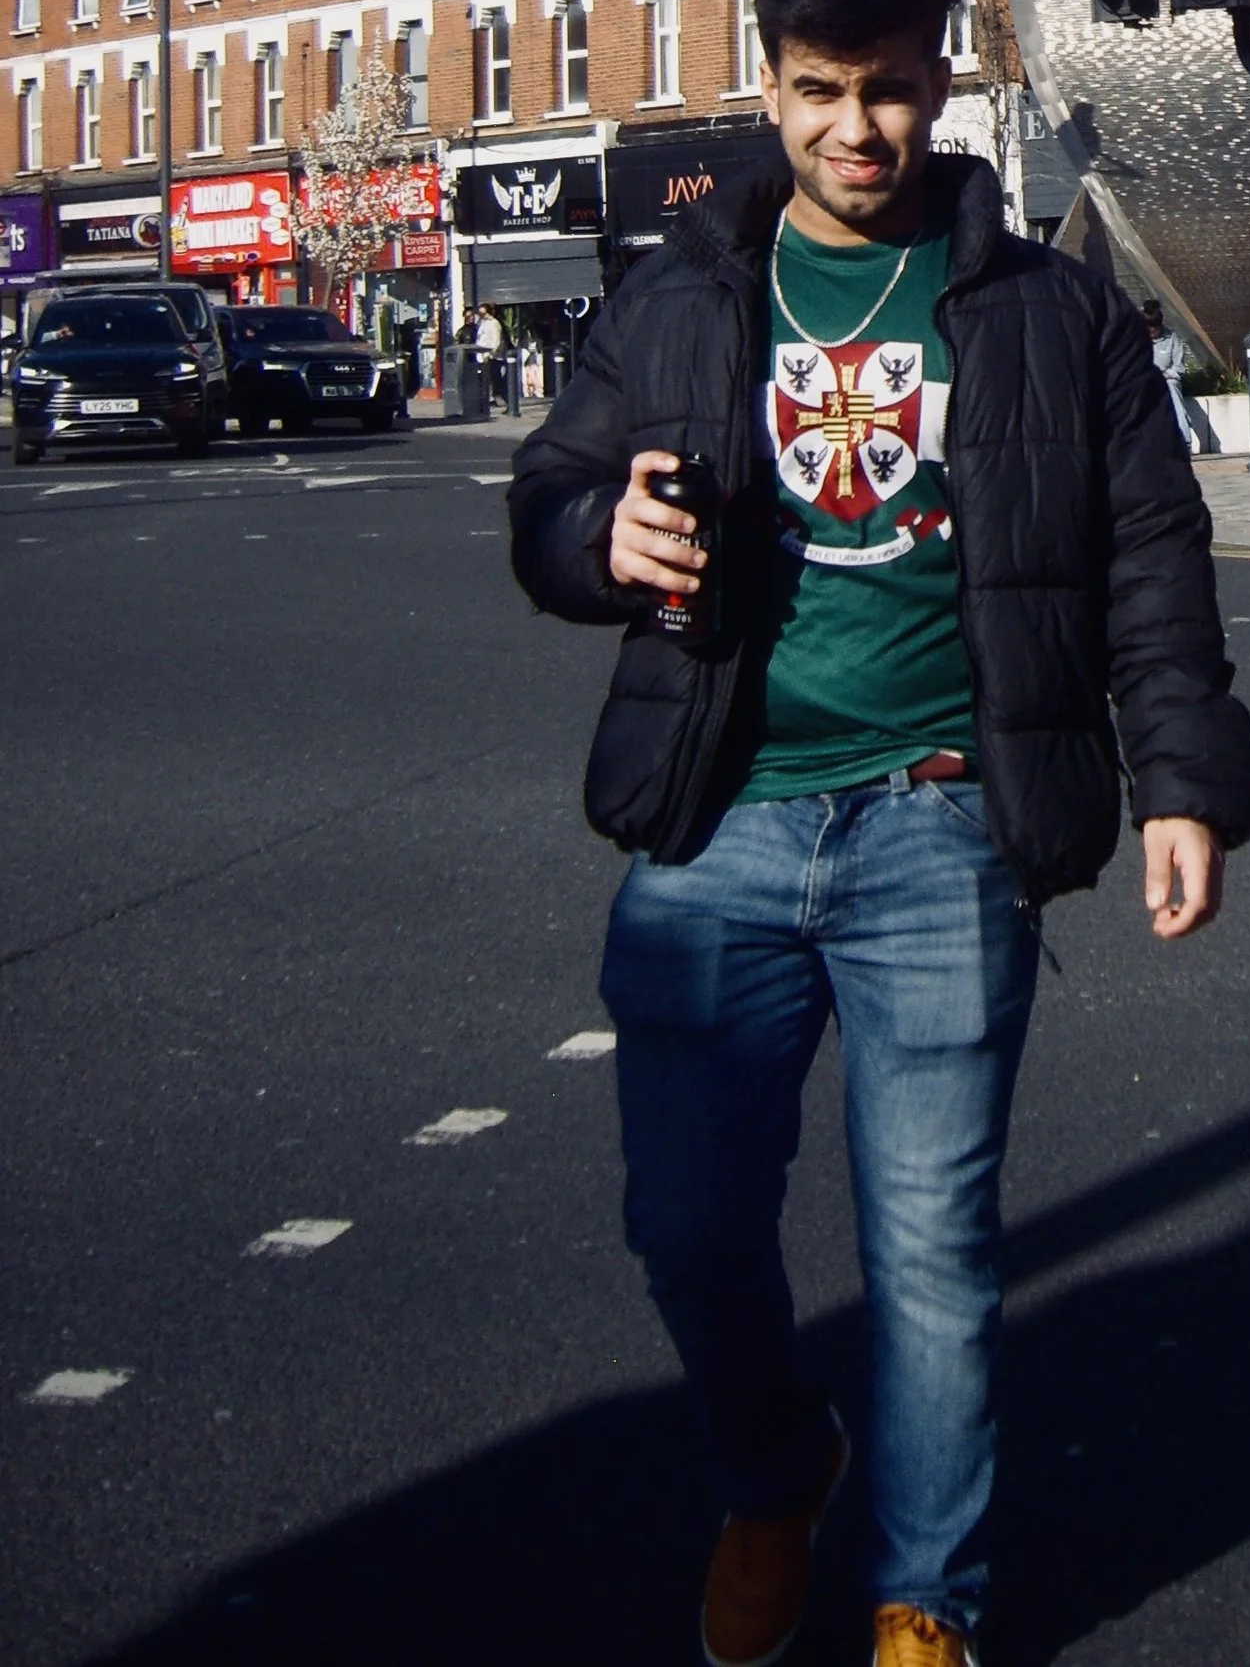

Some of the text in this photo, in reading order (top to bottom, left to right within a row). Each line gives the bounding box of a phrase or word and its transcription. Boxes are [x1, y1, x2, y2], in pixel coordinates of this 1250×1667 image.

[509, 184, 546, 216] T&E
[532, 216, 552, 224] SHOP
[87, 226, 132, 242] TATIANA
[405, 245, 441, 255] CARPET
